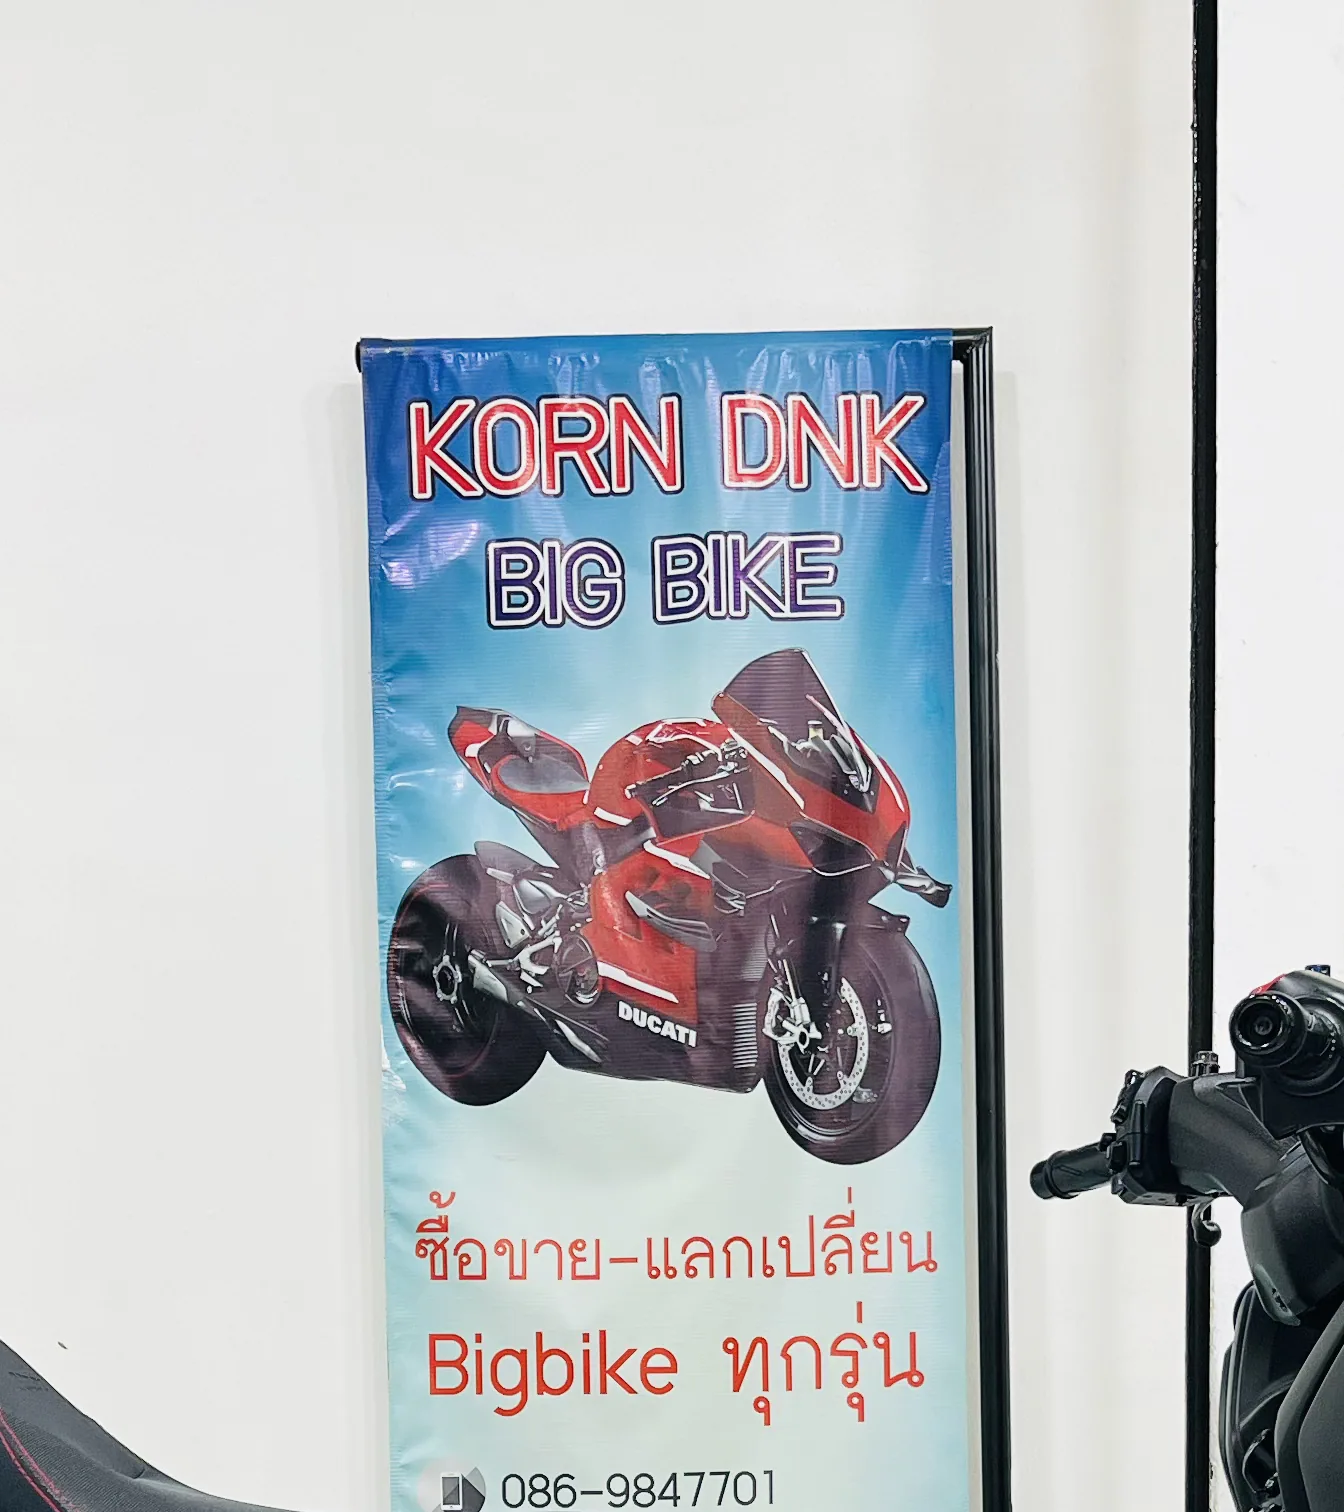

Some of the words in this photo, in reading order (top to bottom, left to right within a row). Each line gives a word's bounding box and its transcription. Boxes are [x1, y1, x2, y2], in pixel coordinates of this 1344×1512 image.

[408, 394, 683, 501] KORN
[719, 394, 929, 494] DNK
[486, 538, 626, 630] BIG
[651, 531, 845, 625] BIKE
[617, 1000, 697, 1048] DUCATI
[427, 1329, 679, 1417] Bigbike
[721, 1300, 926, 1427] ทุกรุ่น
[500, 1469, 776, 1510] 086-9847701
